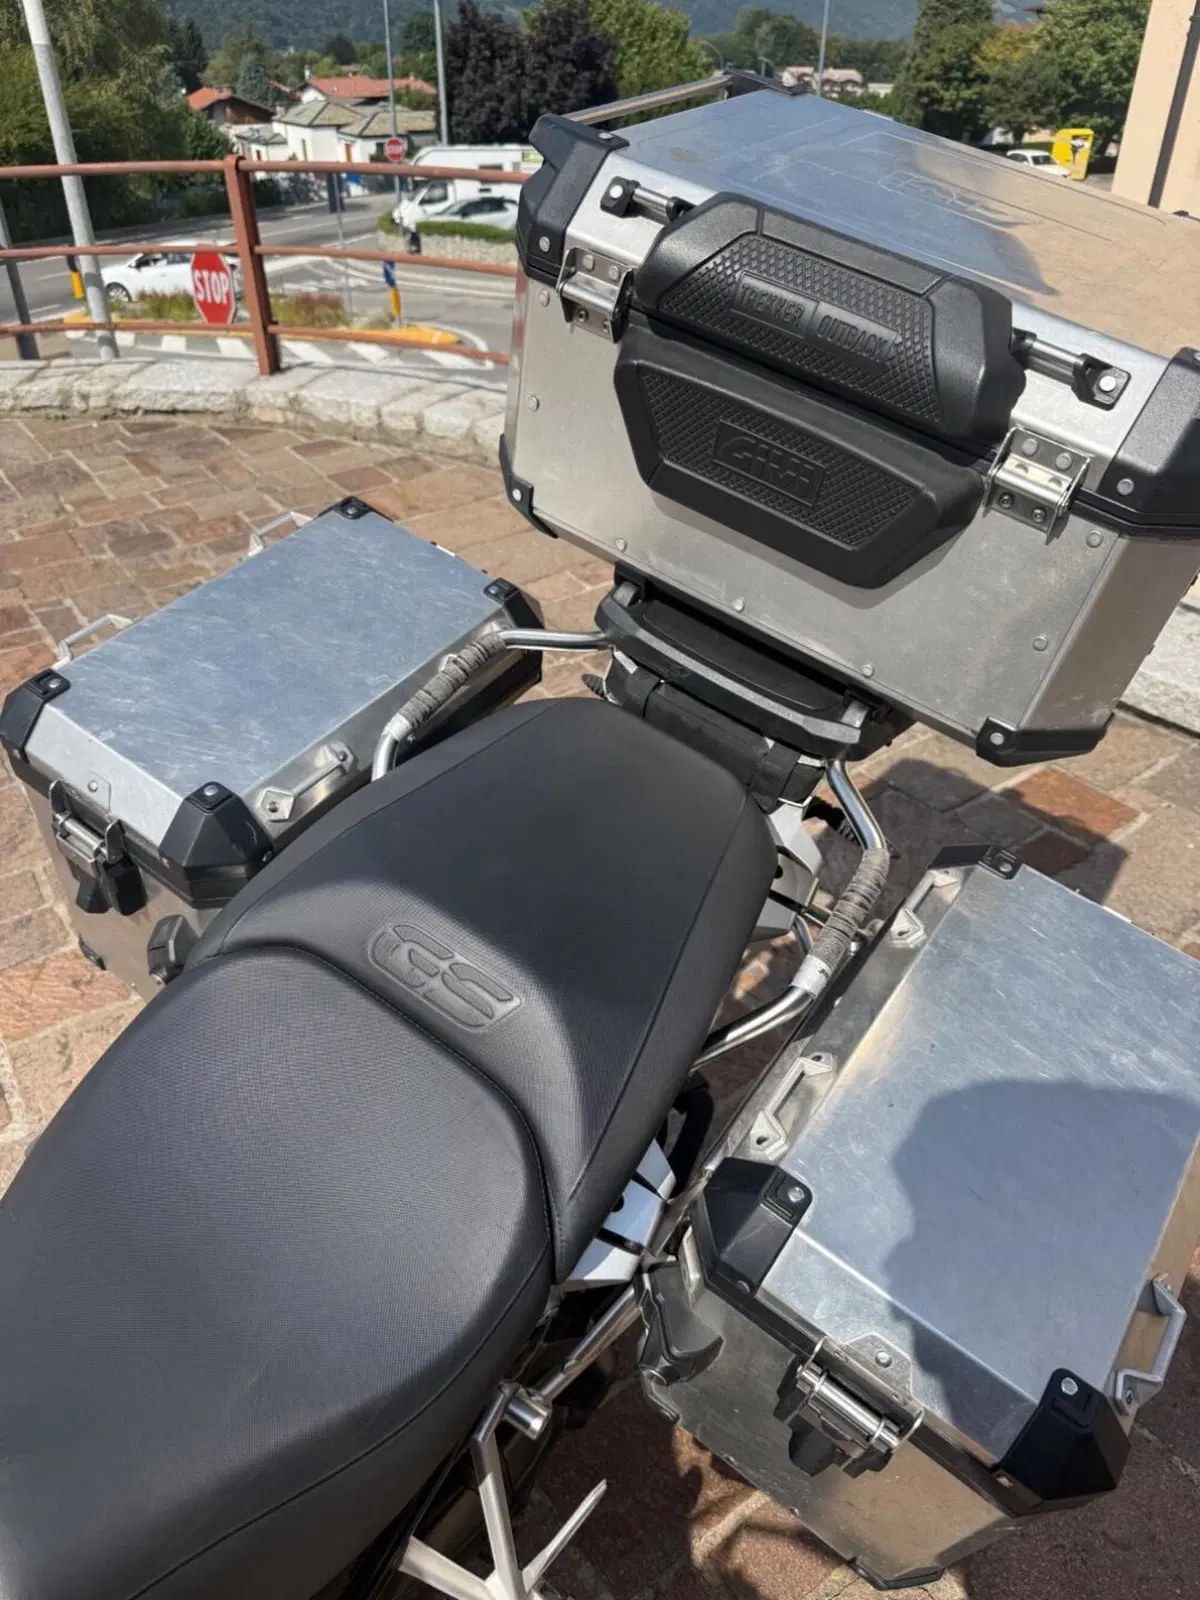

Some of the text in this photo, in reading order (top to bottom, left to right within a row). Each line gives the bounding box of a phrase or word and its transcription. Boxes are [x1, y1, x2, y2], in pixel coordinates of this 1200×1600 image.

[194, 271, 229, 304] STOP
[817, 315, 889, 360] OUTBACK
[717, 436, 815, 498] GIVI
[369, 923, 522, 1031] GS
